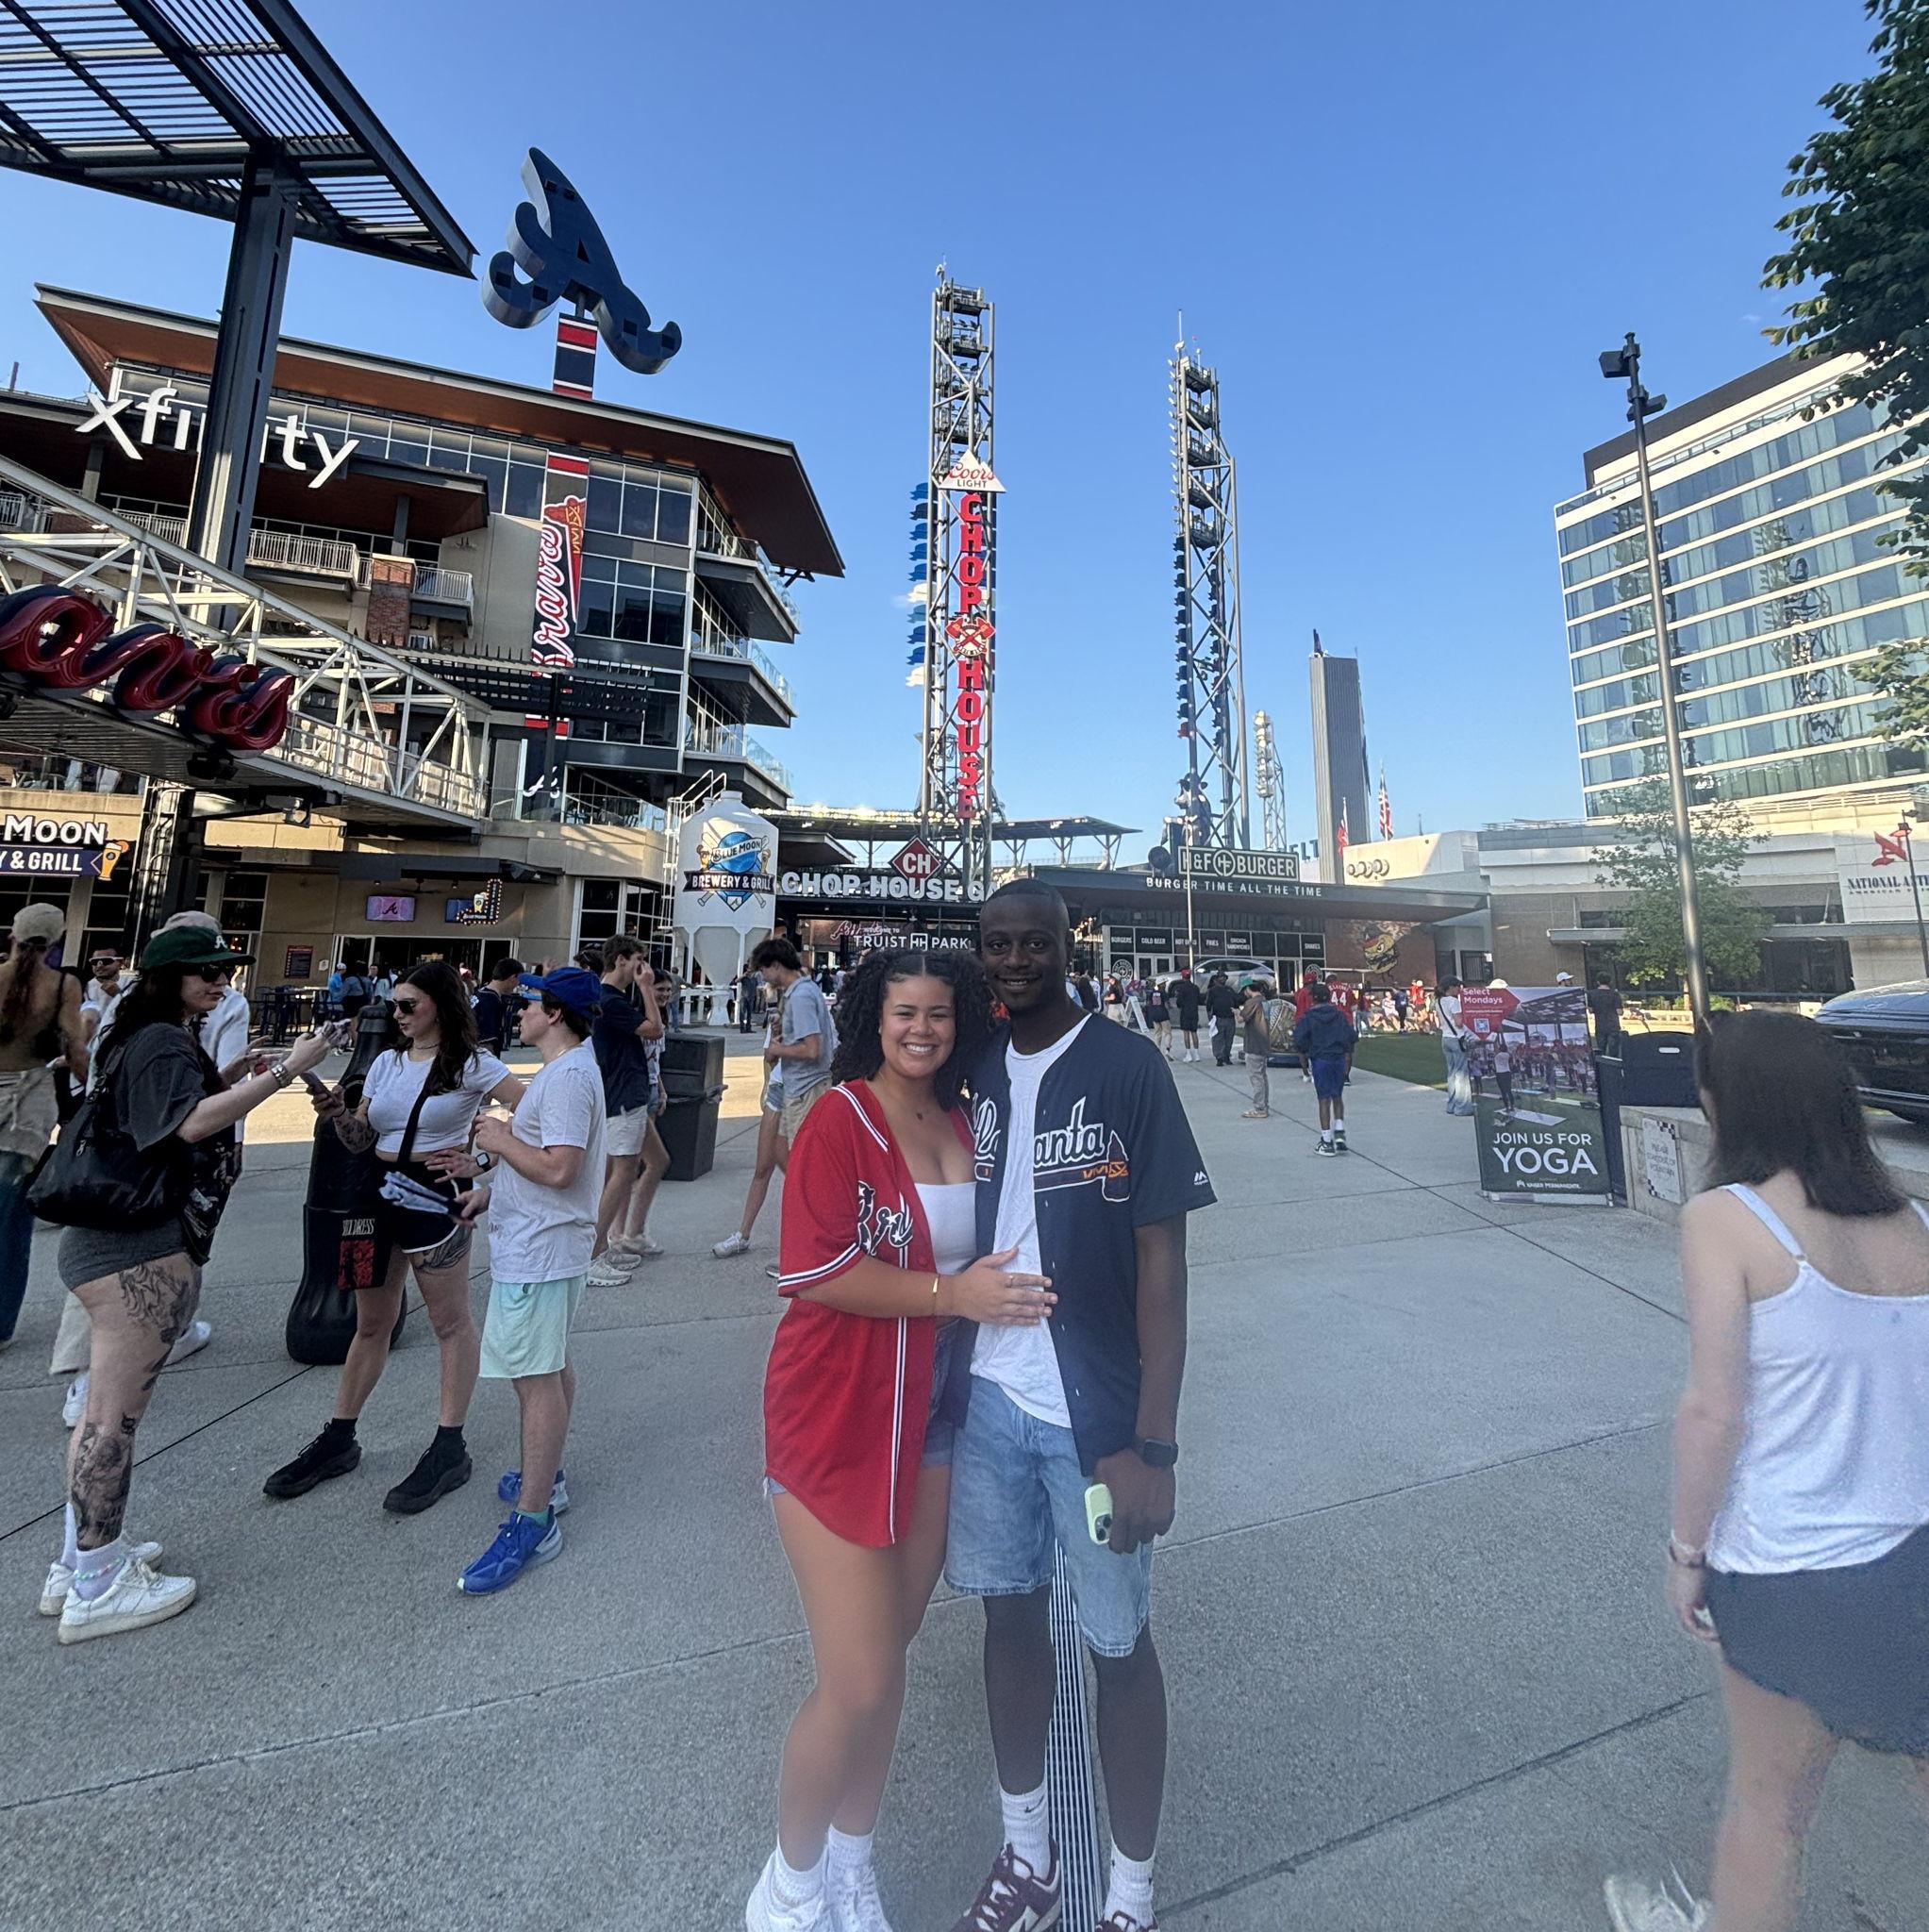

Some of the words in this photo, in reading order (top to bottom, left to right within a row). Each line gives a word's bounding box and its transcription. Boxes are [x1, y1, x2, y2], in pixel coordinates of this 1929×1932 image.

[75, 388, 359, 489] xfity
[948, 462, 995, 481] Coors
[956, 478, 988, 489] LIGHT
[959, 492, 983, 614] CHOP
[956, 659, 983, 819] HOUSE
[3, 814, 107, 845] MOON
[713, 847, 738, 862] BLUE
[739, 839, 761, 852] MOON
[9, 851, 25, 869] &
[27, 852, 83, 871] GRILL
[902, 852, 931, 874] CH
[1237, 856, 1295, 877] BURGER
[692, 875, 740, 889] BREWERY
[741, 876, 751, 889] &
[751, 876, 772, 891] GRILL
[781, 872, 860, 896] CHOP
[870, 875, 960, 900] HOUSE
[1146, 876, 1198, 890] BURGER
[1205, 880, 1234, 891] TIME
[1239, 883, 1261, 893] ALL
[1267, 884, 1289, 894] THE
[1294, 885, 1322, 896] TIME
[1848, 876, 1901, 889] NATIONAL
[854, 935, 907, 948] TRUIST
[931, 937, 969, 949] PARK
[1331, 991, 1347, 1007] 44
[1464, 996, 1504, 1005] Mondays
[1492, 1132, 1528, 1145] JOIN
[1533, 1132, 1554, 1145] US
[1558, 1133, 1592, 1146] FOR
[1492, 1147, 1598, 1175] YOGA
